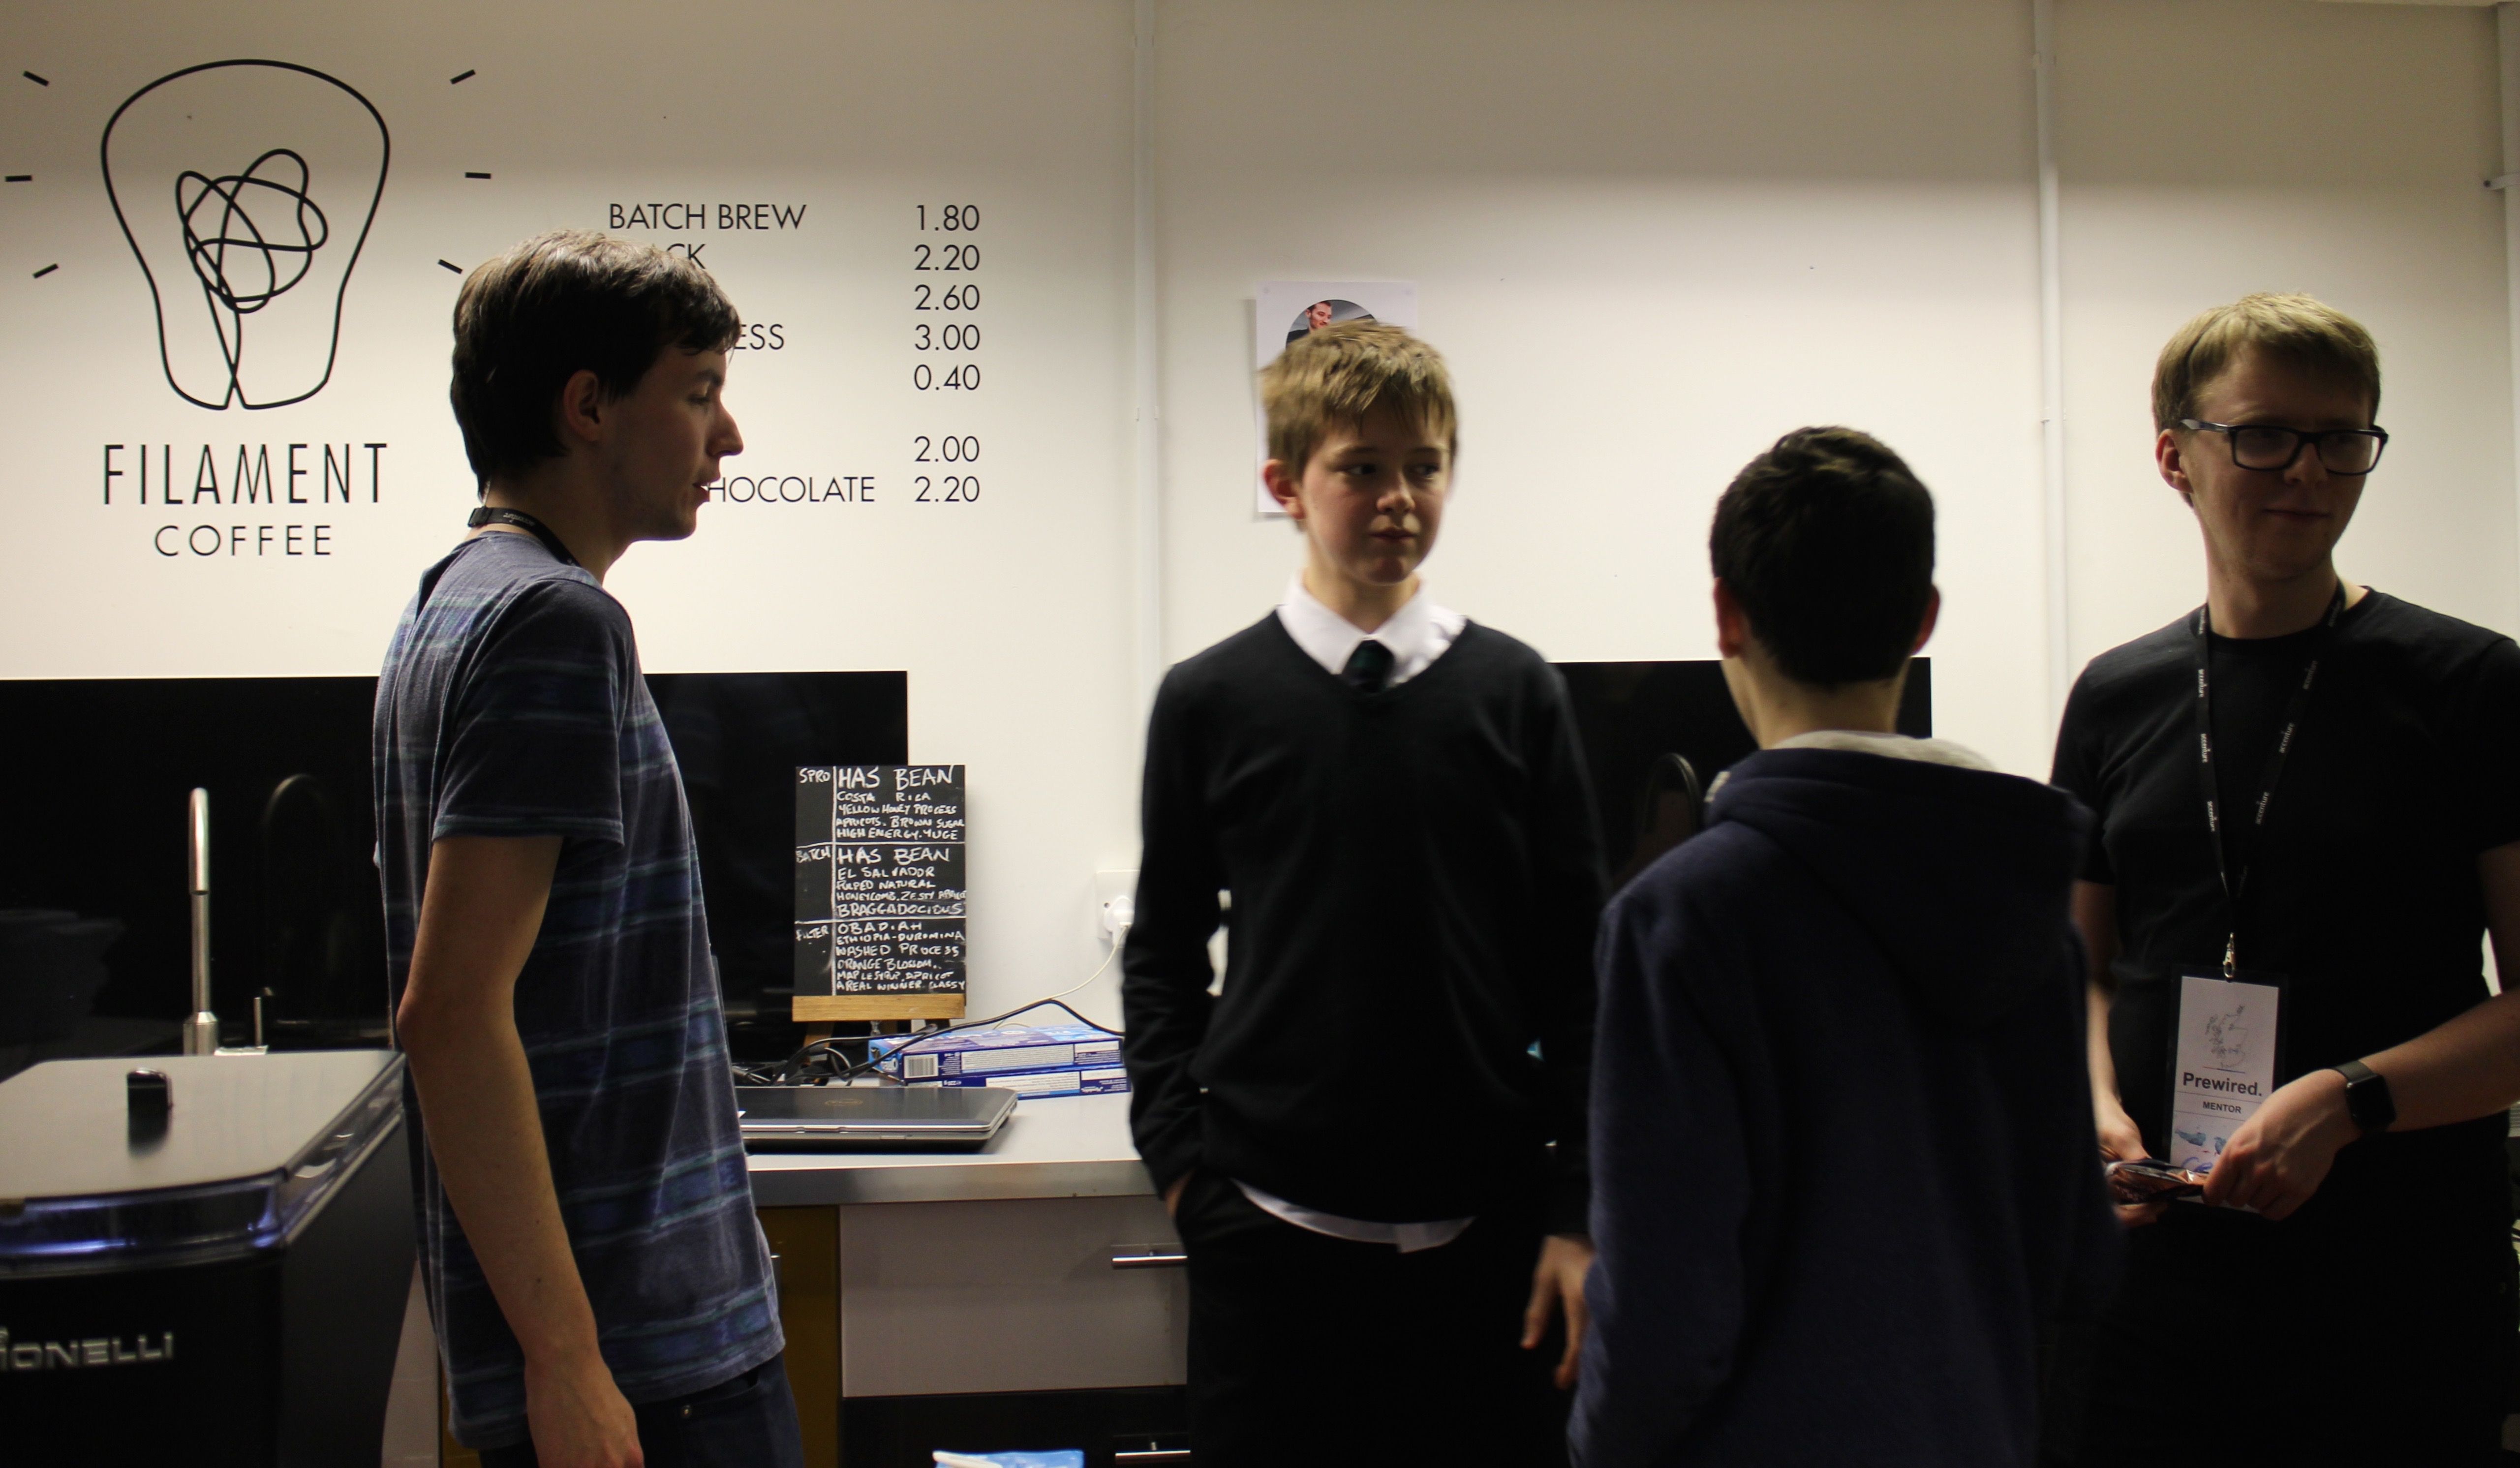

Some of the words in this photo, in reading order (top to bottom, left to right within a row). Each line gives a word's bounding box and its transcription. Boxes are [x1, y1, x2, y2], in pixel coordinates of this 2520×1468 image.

[610, 203, 705, 230] BATCH
[718, 203, 807, 230] BREW
[917, 204, 980, 231] 1.80
[915, 244, 980, 271] 2.20
[915, 284, 980, 310] 2.60
[915, 324, 980, 351] 3.00
[914, 364, 980, 391] 0.40
[915, 436, 980, 462] 2.00
[104, 443, 388, 505] FILAMENT
[708, 476, 875, 503] HOCOLATE
[915, 476, 980, 502] 2.20
[154, 525, 332, 556] COFFEE
[799, 767, 831, 784] SPRO
[838, 765, 881, 789] HAS
[893, 765, 954, 791] BEAN
[836, 791, 876, 804] COSTA
[895, 792, 931, 802] RICA
[838, 803, 880, 816] YELLOW
[913, 803, 957, 815] PROCESS
[890, 815, 933, 828] BROWN
[836, 827, 866, 838] HIGH
[796, 846, 831, 863] BATCH
[837, 847, 882, 865] HAS
[893, 847, 950, 866] BEAN
[837, 867, 857, 881] EL
[878, 879, 936, 889] NATURAL
[796, 925, 829, 941] FILTER
[837, 921, 922, 935] OBADIAH
[836, 945, 891, 958] WASHED
[898, 943, 959, 957] PROCESS
[837, 958, 883, 970] ORANGE
[836, 970, 873, 980] MAPLE
[845, 980, 872, 992] REAL
[2182, 1071, 2262, 1097] Prewired.
[2202, 1101, 2242, 1114] MENTOR
